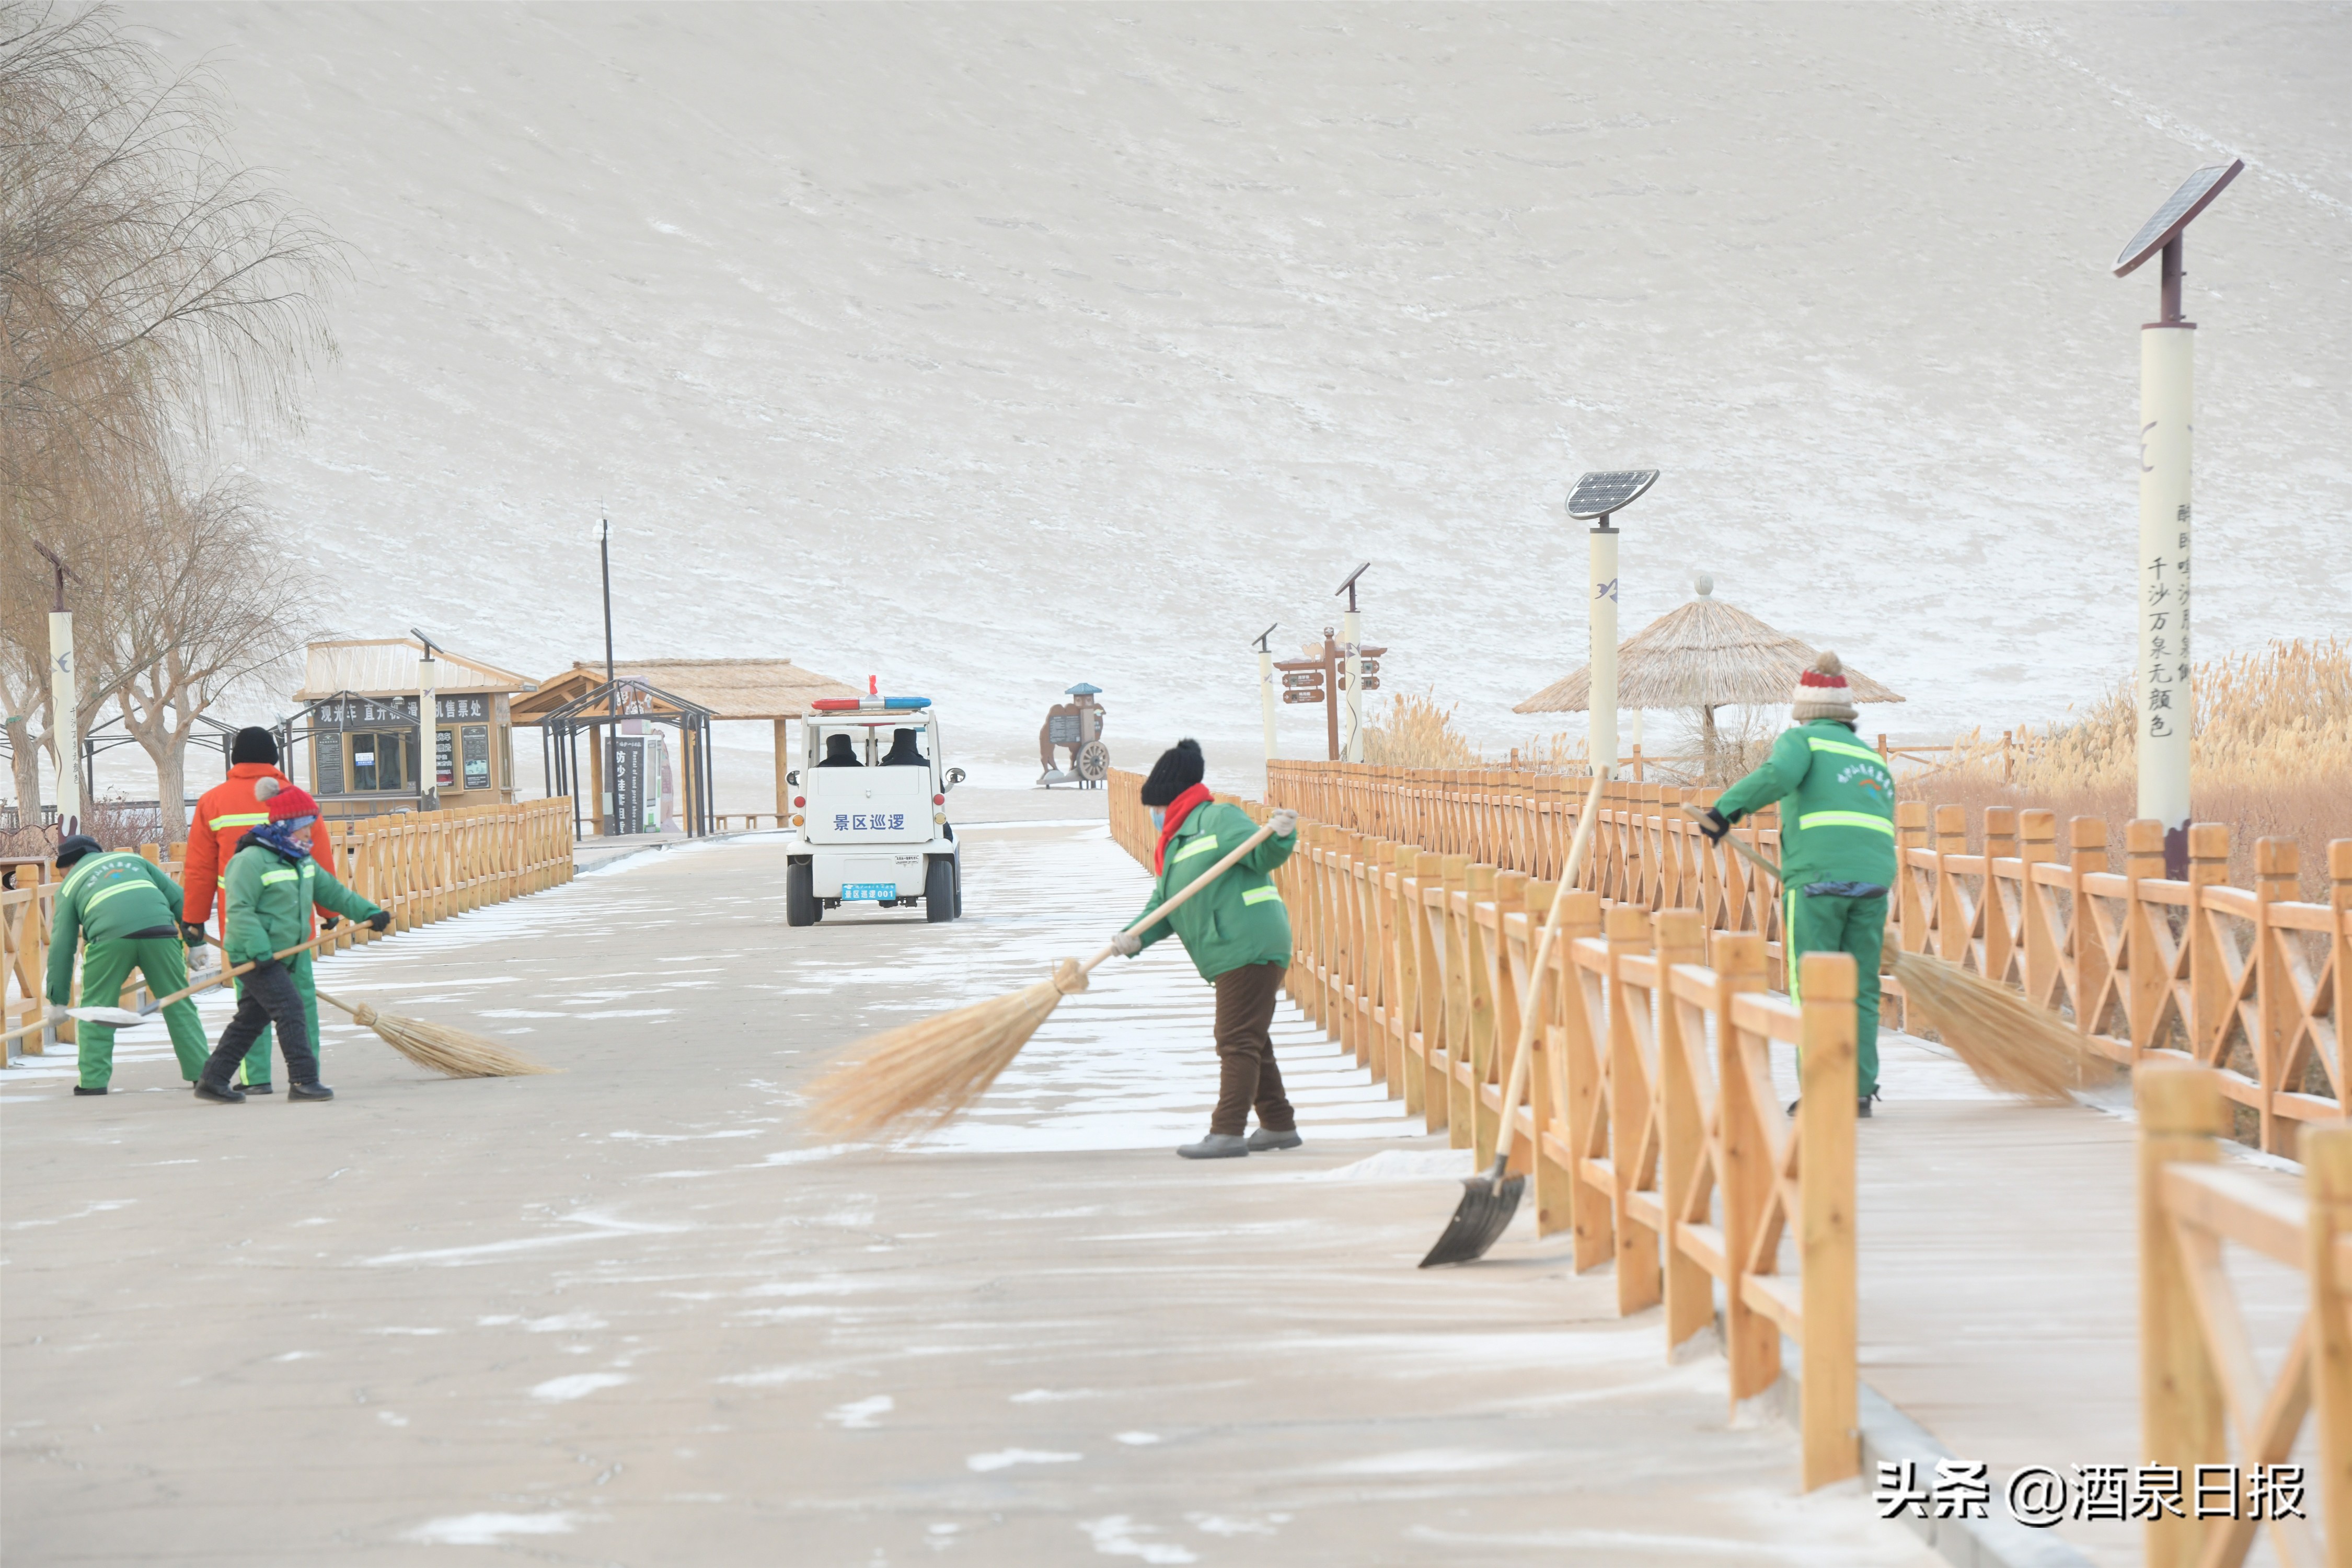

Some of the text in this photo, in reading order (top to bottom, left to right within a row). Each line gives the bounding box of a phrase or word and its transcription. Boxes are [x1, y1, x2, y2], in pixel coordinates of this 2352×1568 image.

[320, 705, 356, 722] 观光车
[408, 699, 481, 718] 滑机售票处
[833, 814, 905, 831] 景区巡逻
